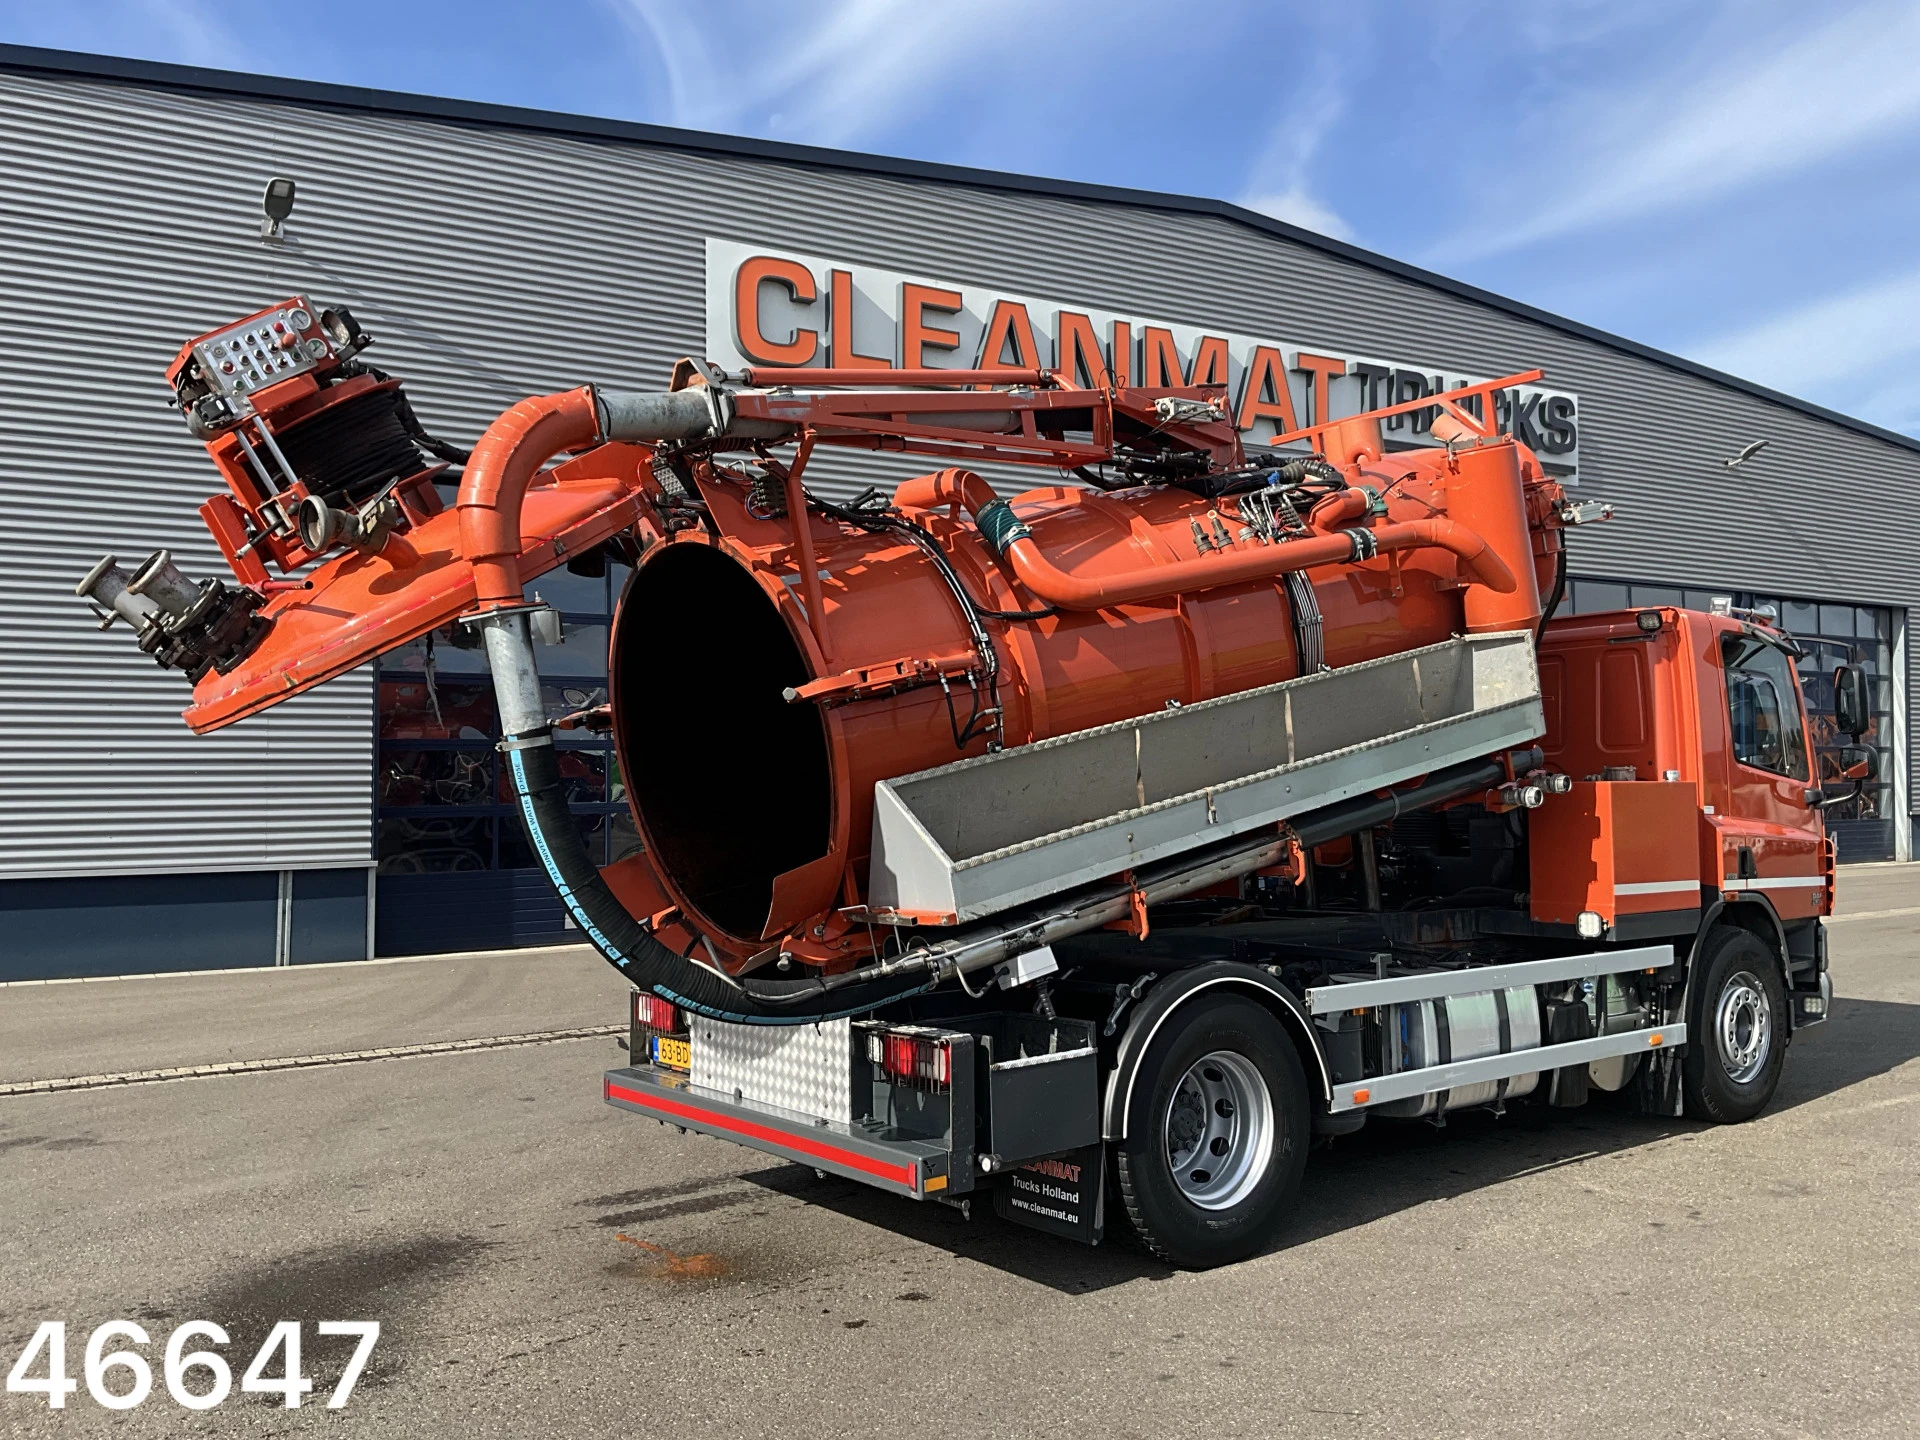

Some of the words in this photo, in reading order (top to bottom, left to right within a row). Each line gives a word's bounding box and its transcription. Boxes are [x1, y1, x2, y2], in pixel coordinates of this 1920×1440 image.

[733, 256, 1346, 436] CLEANMAT
[514, 764, 524, 783] HOSE
[523, 799, 536, 826] WATER
[532, 827, 552, 866] UNIVERSAL
[1020, 1160, 1081, 1182] ANMAT
[1012, 1174, 1040, 1193] Trucks
[1042, 1183, 1079, 1204] Holland
[1011, 1197, 1079, 1224] www.cleanmat.eu
